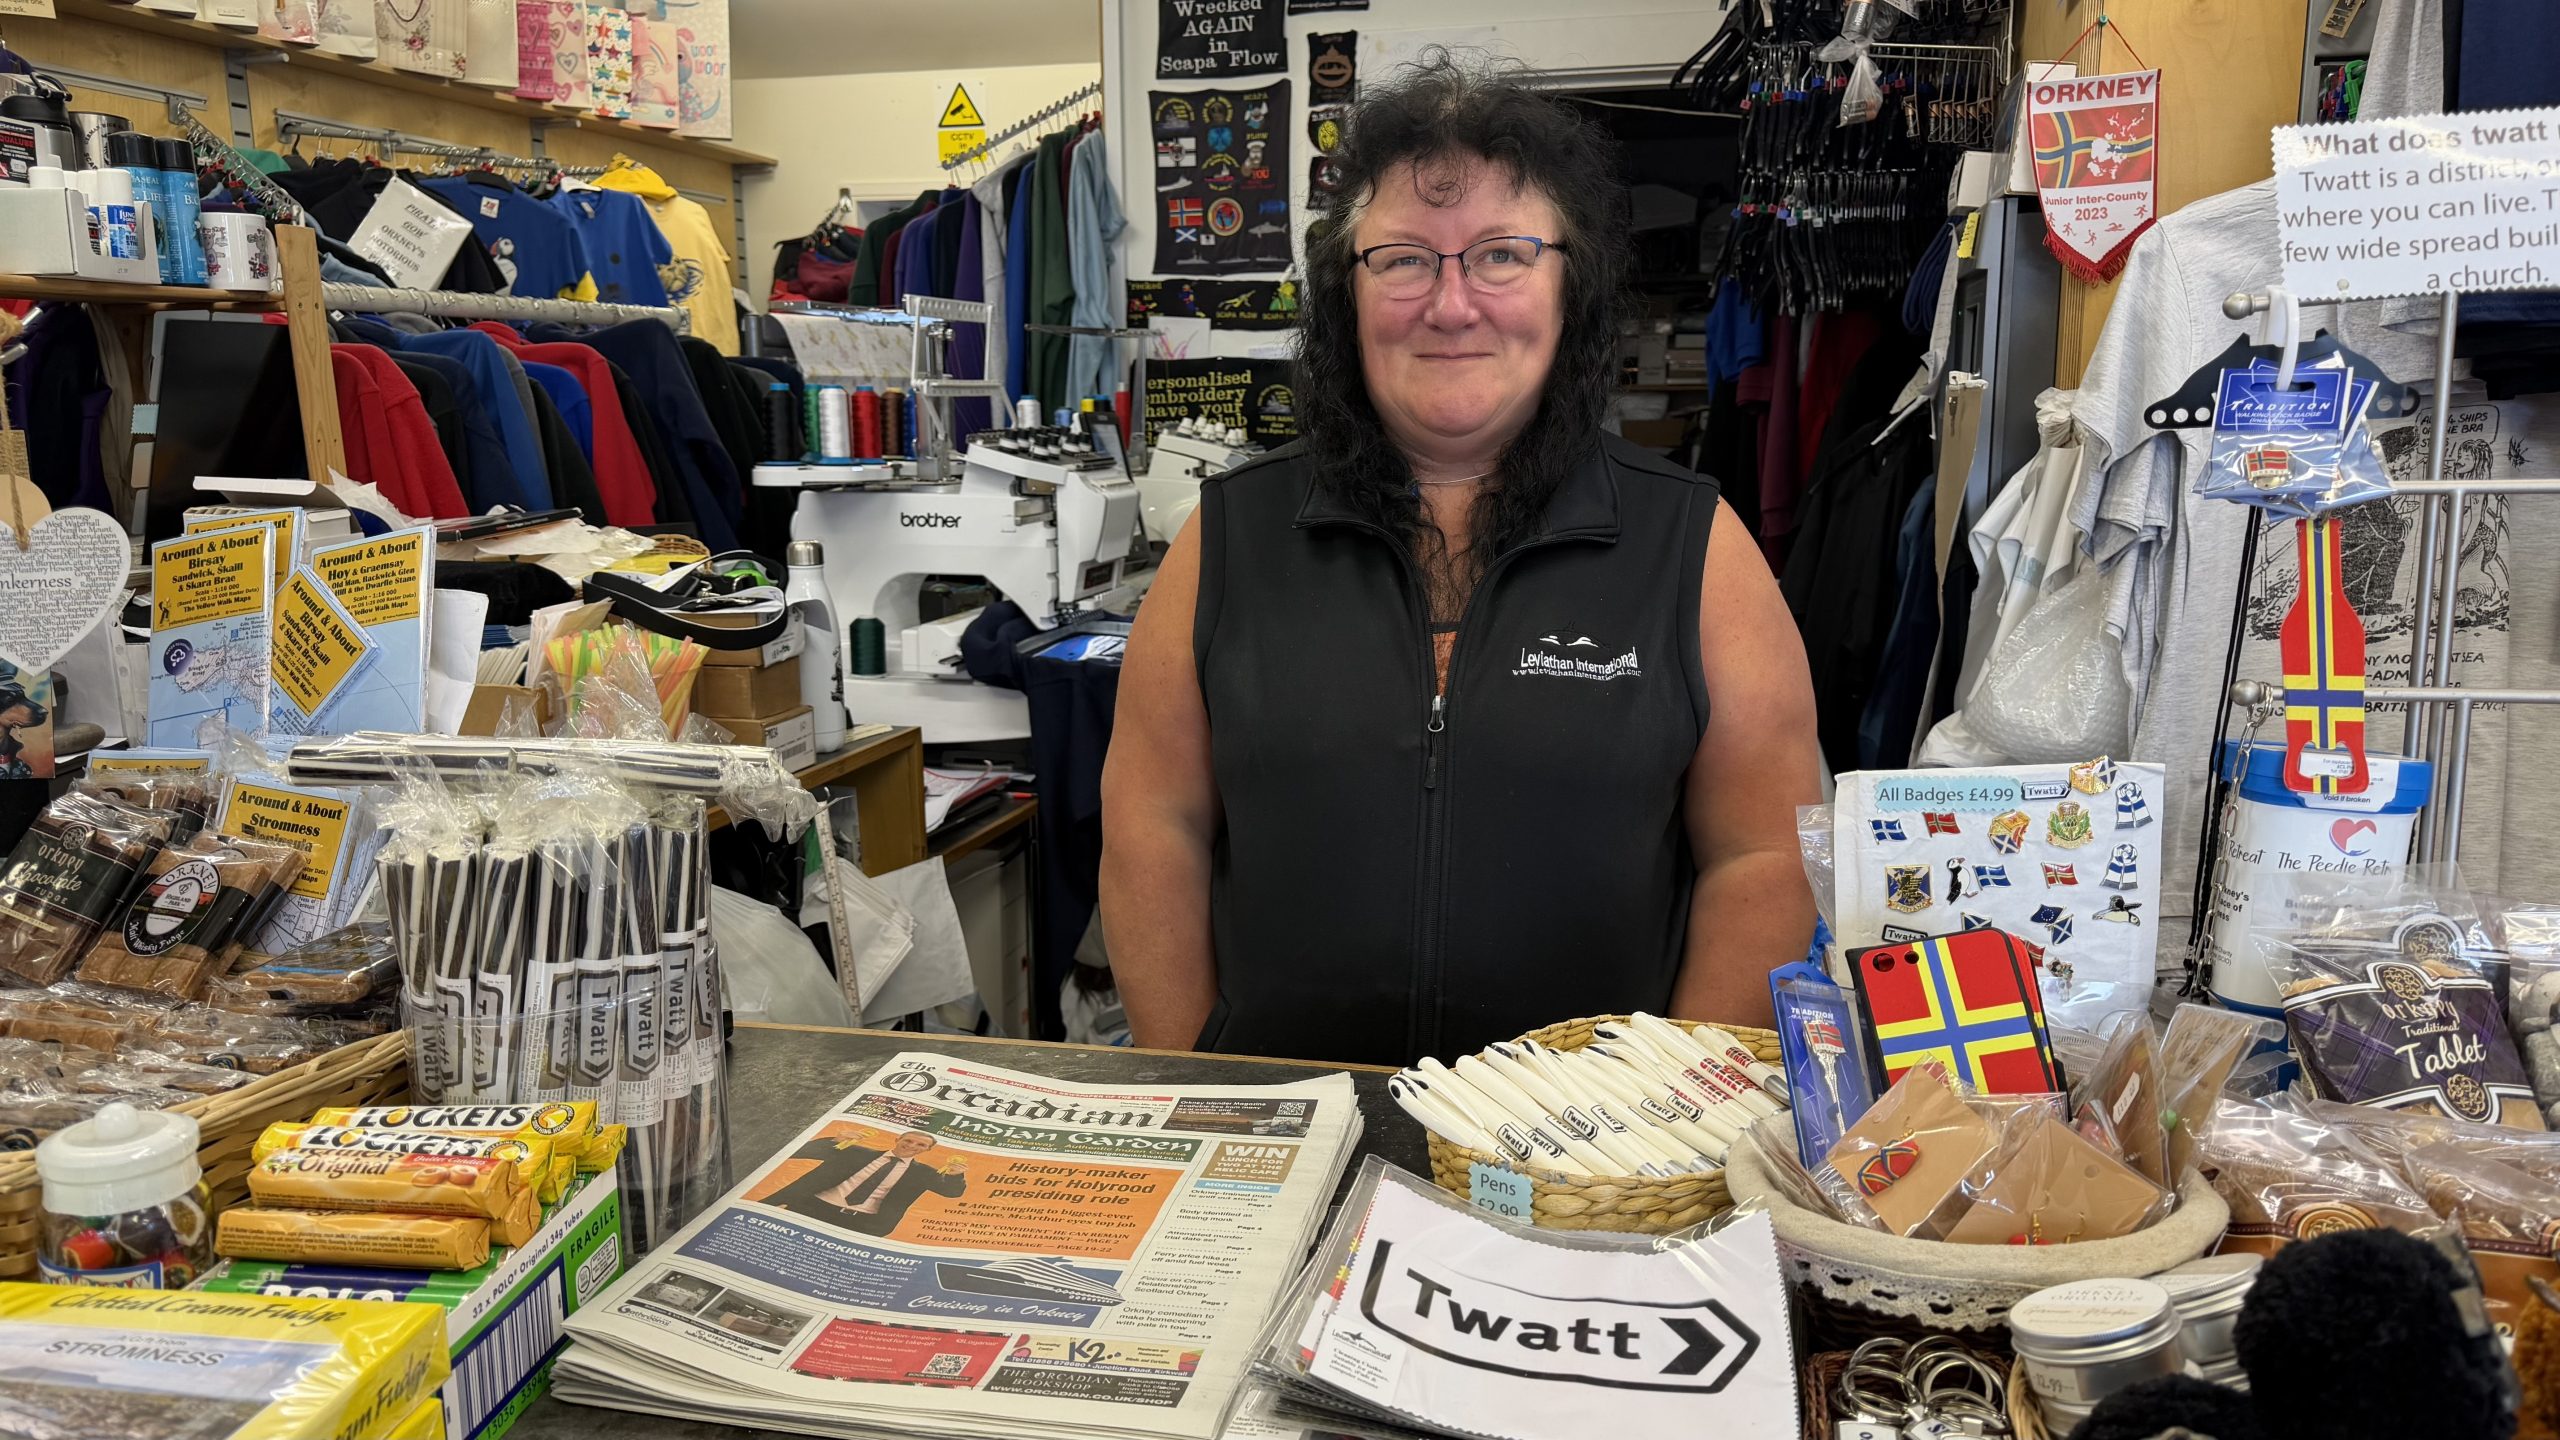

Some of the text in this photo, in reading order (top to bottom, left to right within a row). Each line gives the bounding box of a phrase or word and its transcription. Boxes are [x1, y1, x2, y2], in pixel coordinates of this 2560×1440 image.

[1174, 0, 1263, 17] Wrecked
[1182, 16, 1255, 37] AGAIN
[1208, 37, 1230, 53] in
[1160, 50, 1279, 73] Scapa Flow
[2034, 75, 2155, 105] ORKNEY
[951, 133, 974, 141] CCTV
[2303, 121, 2548, 157] What does twatt
[2299, 160, 2529, 192] Twatt is a district,
[2044, 191, 2148, 206] Junior Inter-County
[2074, 207, 2109, 221] 2023
[2283, 193, 2537, 229] where you can live.
[381, 225, 426, 258] ORKNEY'S
[2284, 241, 2329, 262] few
[2336, 236, 2401, 260] wide
[2408, 228, 2499, 260] spread
[371, 234, 421, 272] NOTORIOUS
[2426, 261, 2550, 289] a church.
[1147, 370, 1252, 390] ersonalised
[1146, 402, 1244, 417] have your
[2231, 401, 2331, 412] TRADITION
[2457, 412, 2488, 423] SHIPS
[2462, 423, 2484, 434] BRA
[901, 512, 961, 529] brother
[160, 534, 260, 563] Around & About
[319, 539, 417, 569] Around & About
[188, 554, 226, 570] Birsay
[328, 559, 405, 582] Hoy & Graemsay
[172, 563, 244, 584] Sandwick, Skaill
[178, 574, 236, 593] & Skara Brae
[184, 595, 252, 613] The Yellow Walk Maps
[354, 600, 409, 616] Yellow Walk Maps
[290, 579, 358, 657] Around & About
[300, 610, 329, 644] Birsay
[278, 622, 318, 669] & Skara Brae
[282, 609, 332, 667] Sandwick, Skaill
[1520, 645, 1638, 675] Leviathan International
[1879, 787, 2015, 806] All Badges £4.99
[2027, 785, 2059, 796] Twatt
[2323, 794, 2343, 802] Void
[2349, 795, 2371, 803] broken
[238, 790, 344, 821] Around & About
[250, 812, 321, 838] Stromness
[2228, 840, 2266, 864] Retreat
[2278, 852, 2301, 869] The
[2308, 854, 2357, 874] Peedle
[9, 861, 83, 892] Chocolate
[164, 861, 218, 892] ORKNEY
[34, 886, 68, 905] FUDGE
[2233, 904, 2243, 913] of
[128, 921, 187, 953] Malt Whisky Fudge
[669, 958, 688, 1026] Twatt
[590, 986, 611, 1056] Twatt
[637, 981, 656, 1051] Twatt
[1791, 1007, 1834, 1019] TRADITION
[2401, 1019, 2460, 1038] Traditional
[900, 1061, 936, 1072] The
[2395, 1034, 2486, 1079] Tablet
[879, 1070, 1158, 1130] Orcadian
[1646, 1098, 1670, 1116] Twatt
[1672, 1095, 1694, 1115] Twatt
[356, 1105, 532, 1129] LOCKETS
[1567, 1110, 1589, 1132] Twatt
[950, 1114, 1058, 1142] Indian
[1067, 1131, 1193, 1152] Garden
[1502, 1127, 1523, 1151] Twatt
[1530, 1131, 1552, 1152] Twatt
[414, 1156, 452, 1164] Butter
[1221, 1157, 1259, 1165] LUNCH
[1224, 1144, 1290, 1160] WIN
[298, 1153, 391, 1178] Original
[1008, 1162, 1152, 1180] History-maker
[985, 1174, 1156, 1194] bids for Holyrood
[1480, 1173, 1516, 1197] Pens
[988, 1187, 1130, 1205] presiding role
[1478, 1198, 1519, 1216] £2.99
[569, 1204, 616, 1259] FRAGILE
[472, 1305, 485, 1319] 32
[485, 1298, 491, 1308] x
[519, 1242, 549, 1274] Original
[548, 1228, 564, 1250] 34g
[564, 1208, 583, 1230] Tubes
[1134, 1287, 1209, 1298] Scotland Orkney
[50, 1292, 348, 1327] Clotted Cream Fudge
[1119, 1313, 1207, 1326] make homecoming
[1406, 1267, 1641, 1361] Twatt
[45, 1339, 225, 1367] STROMNESS
[1069, 1338, 1106, 1363] K2
[1002, 1368, 1113, 1384] THE ORCADIAN
[1012, 1378, 1091, 1391] BOOKSHOP
[989, 1385, 1174, 1406] WWW.ORCADIAN.CO.UK/SHOP
